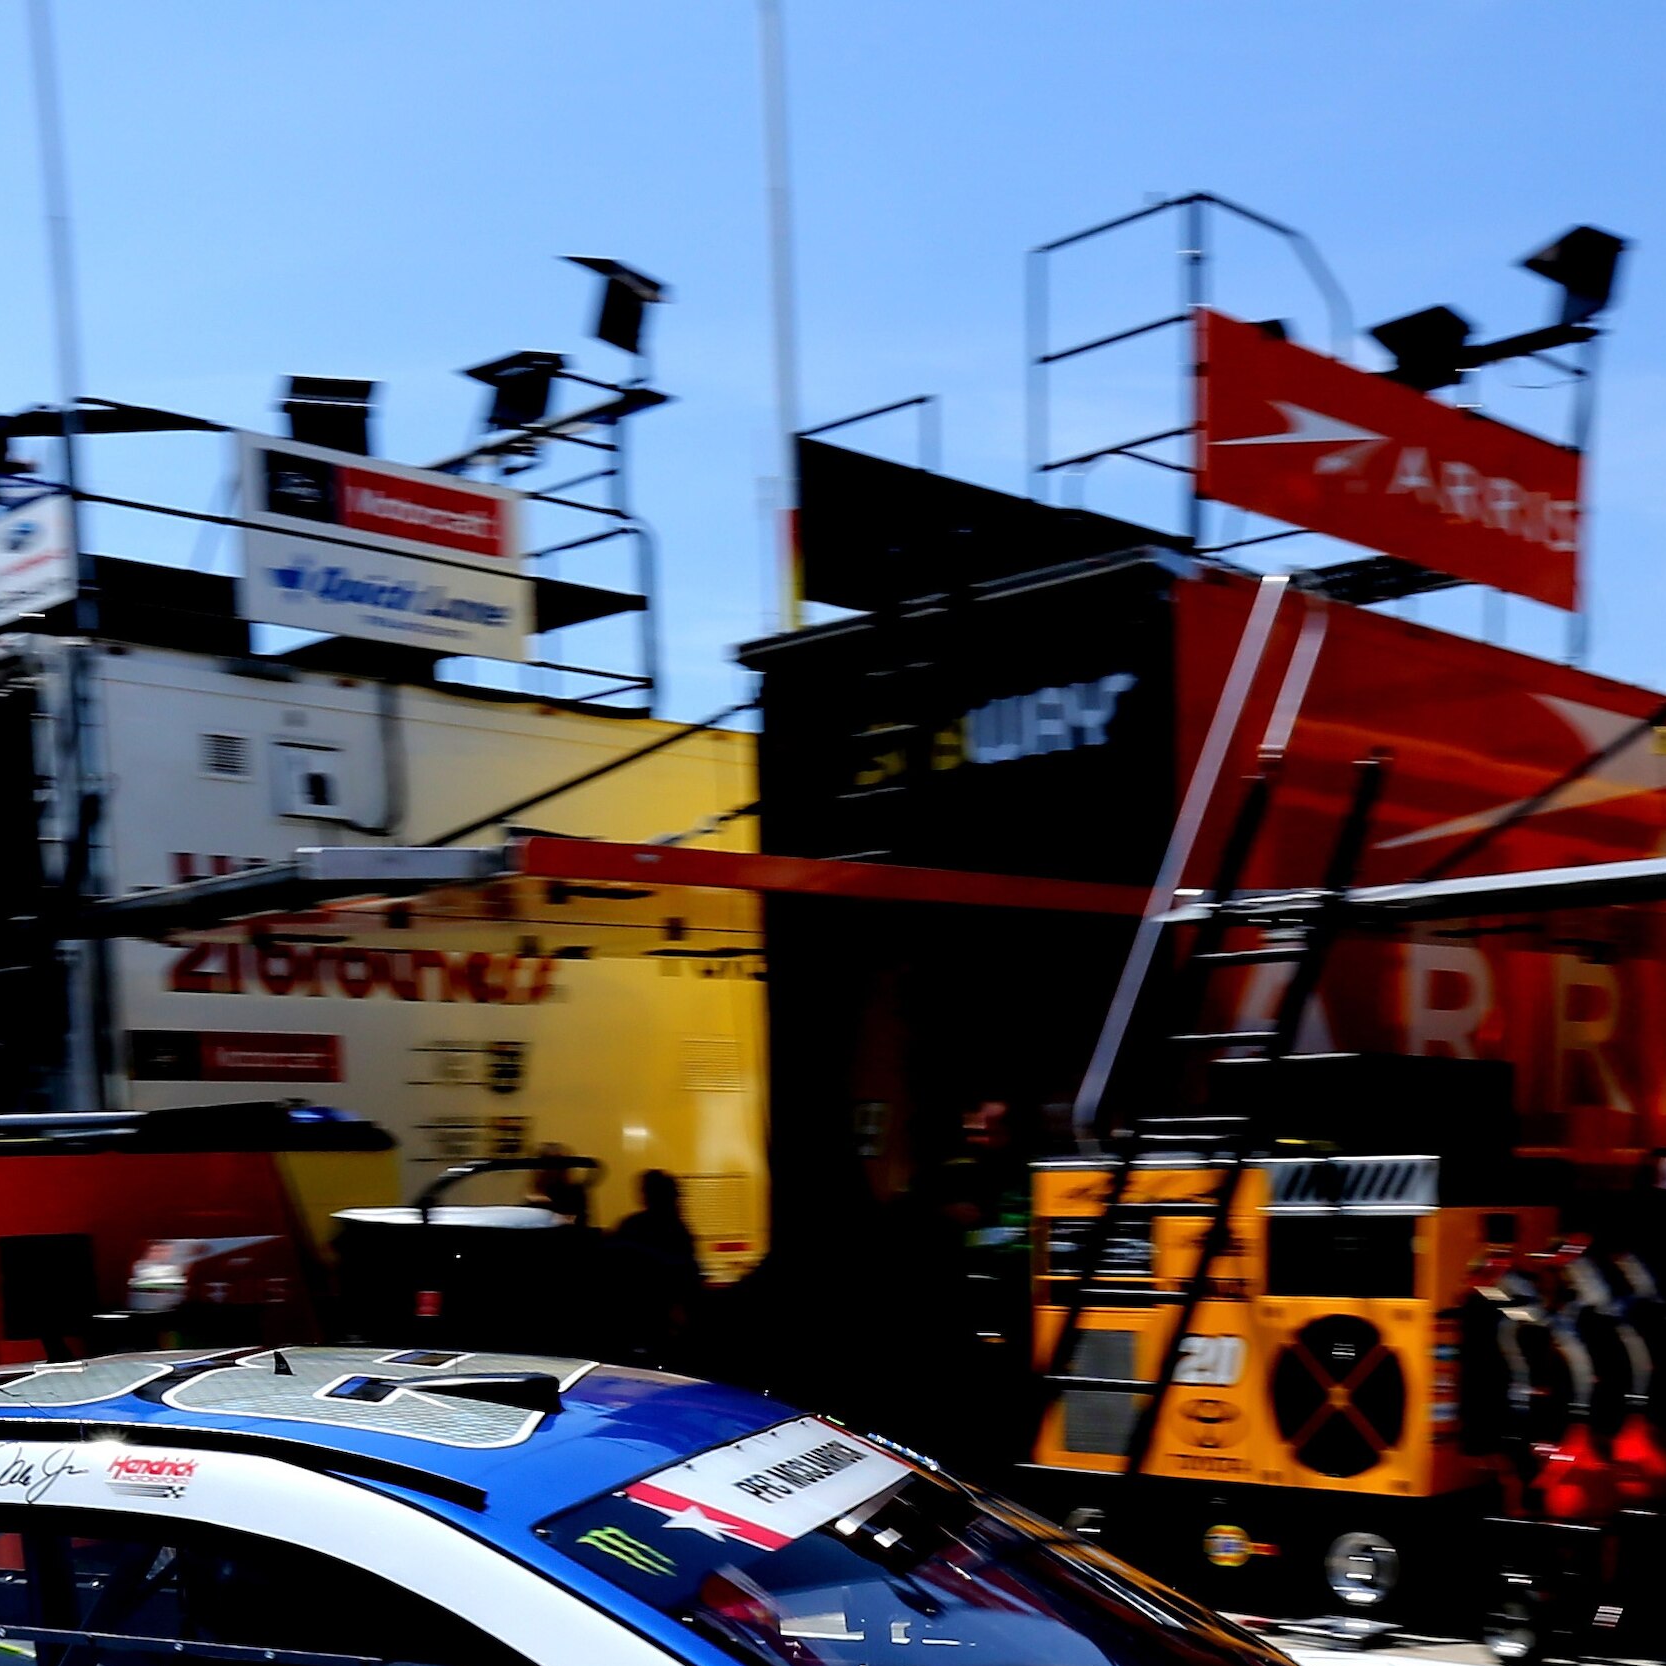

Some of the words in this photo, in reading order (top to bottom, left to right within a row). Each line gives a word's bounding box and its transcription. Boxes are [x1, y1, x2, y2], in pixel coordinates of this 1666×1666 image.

[1386, 447, 1578, 552] ARRIS
[107, 1456, 198, 1480] Hendrick
[732, 1474, 795, 1504] PFC
